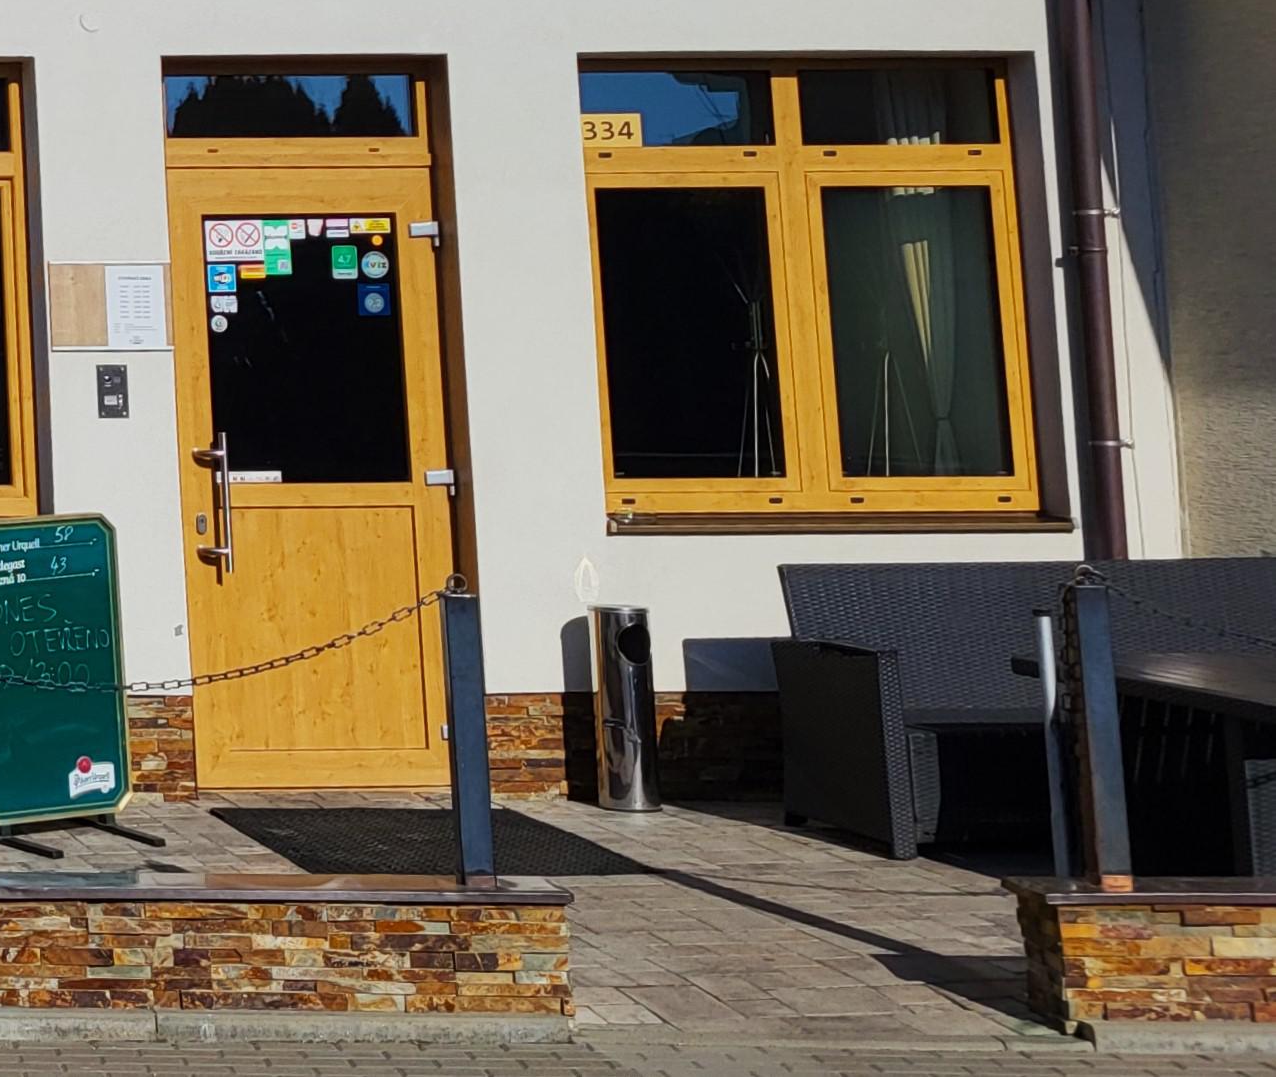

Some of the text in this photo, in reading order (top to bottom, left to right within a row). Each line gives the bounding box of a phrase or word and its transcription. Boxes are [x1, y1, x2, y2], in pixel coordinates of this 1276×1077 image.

[583, 121, 635, 141] 334
[11, 538, 40, 552] Urquell
[50, 556, 67, 575] 43
[17, 573, 26, 583] 10
